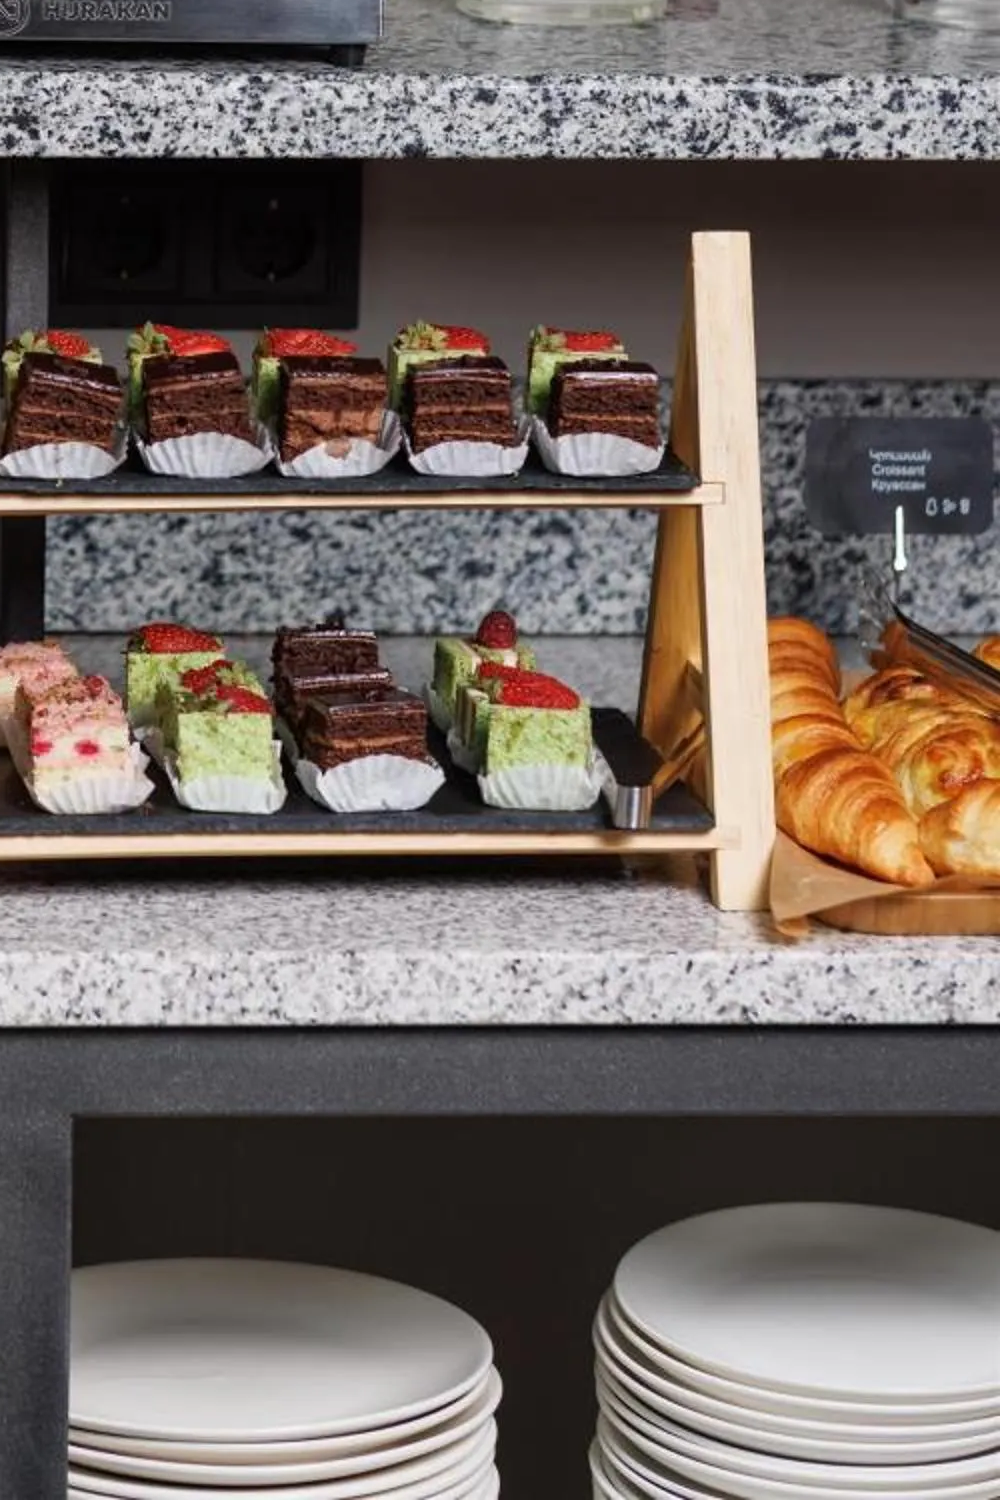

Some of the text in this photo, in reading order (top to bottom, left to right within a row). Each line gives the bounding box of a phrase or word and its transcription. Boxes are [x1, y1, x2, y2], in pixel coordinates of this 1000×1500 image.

[42, 0, 171, 21] HURAKAN
[871, 463, 926, 477] Croissant
[871, 477, 927, 493] Круассан
